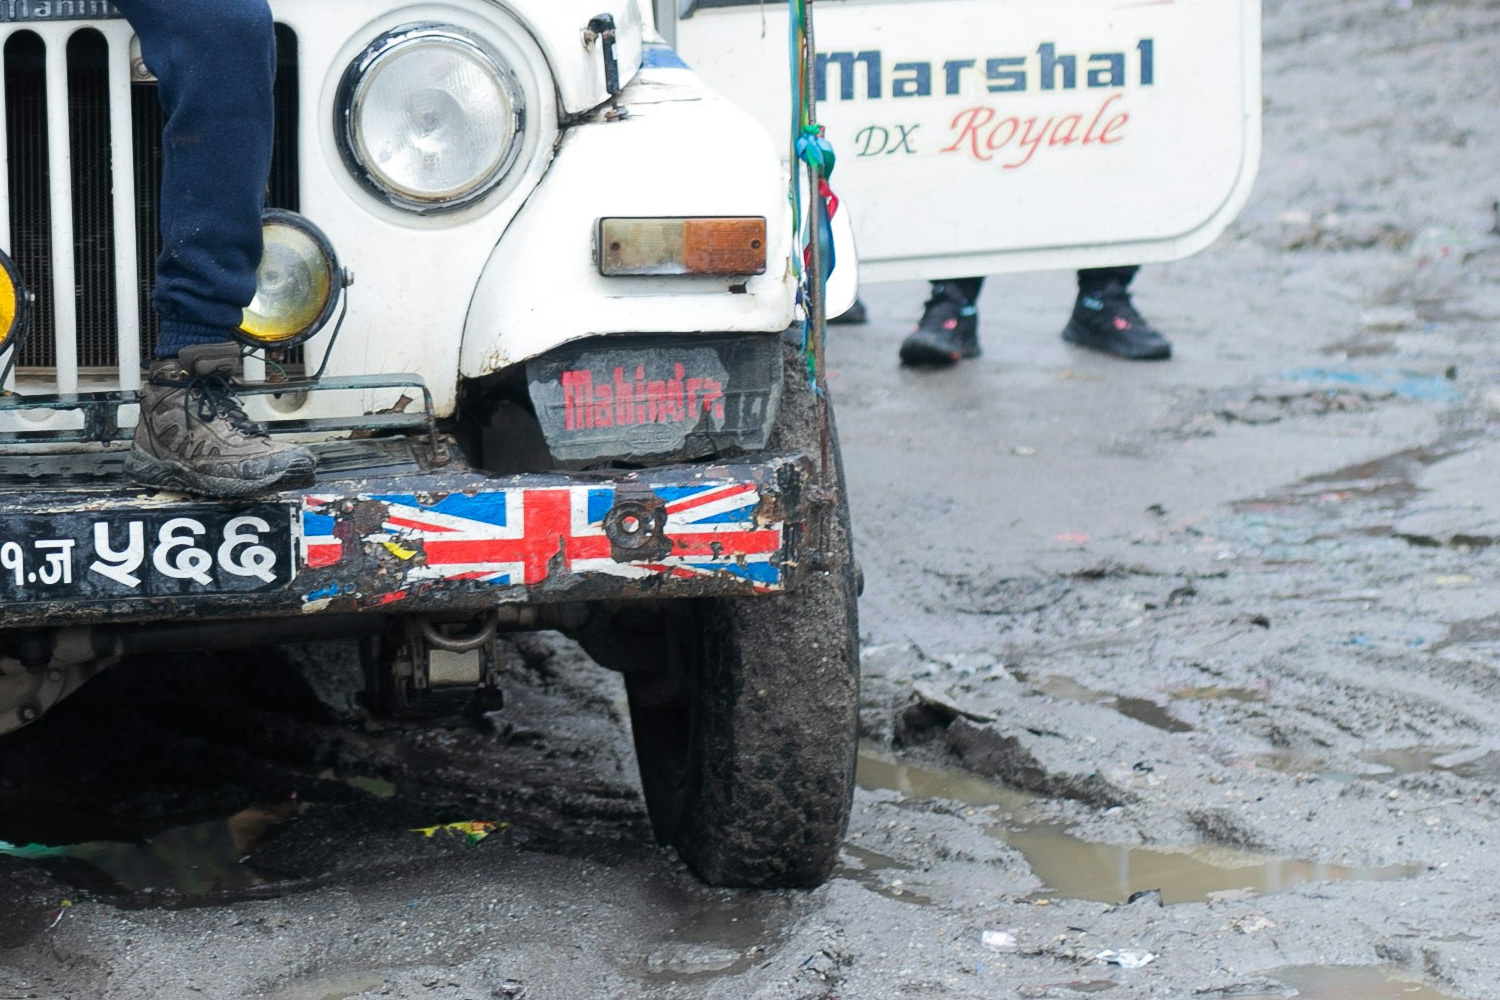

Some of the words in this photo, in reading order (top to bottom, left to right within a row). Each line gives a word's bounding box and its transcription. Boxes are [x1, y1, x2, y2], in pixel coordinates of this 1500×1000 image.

[815, 38, 1154, 102] Marshal
[854, 124, 920, 157] DX
[940, 93, 1130, 169] Royale
[89, 516, 277, 588] ५६६
